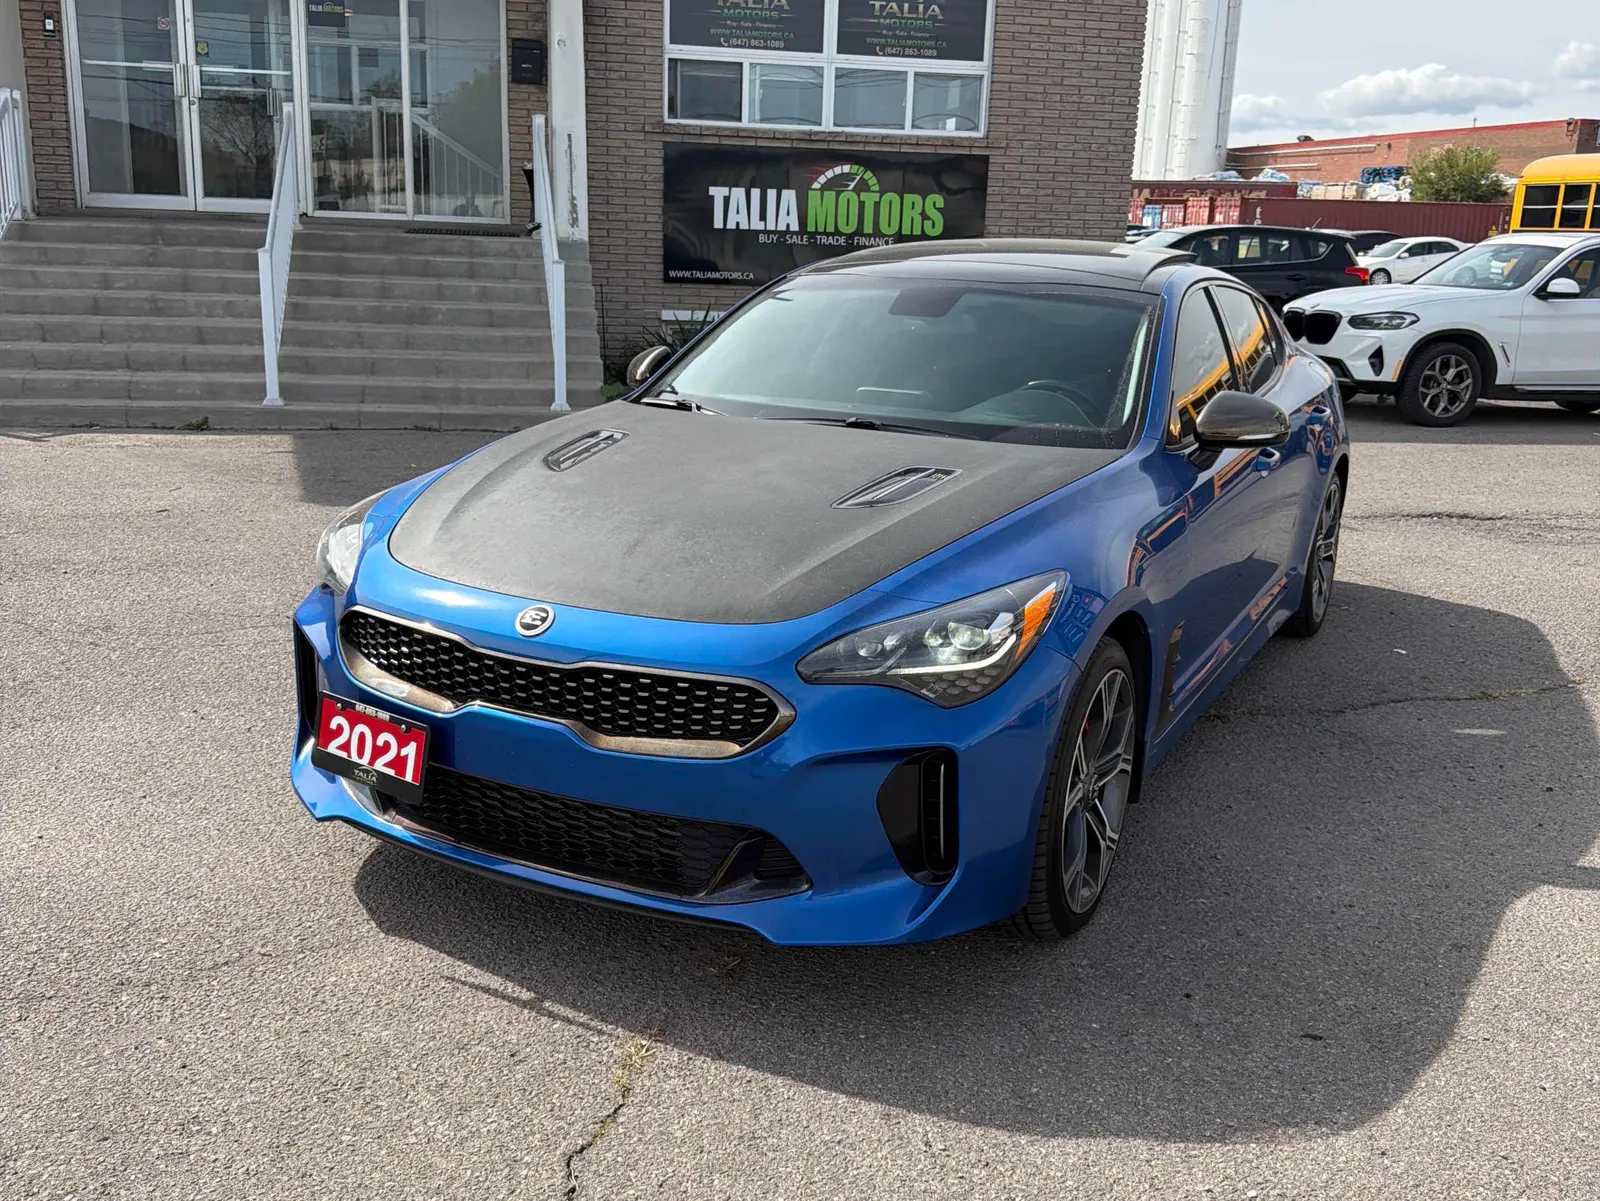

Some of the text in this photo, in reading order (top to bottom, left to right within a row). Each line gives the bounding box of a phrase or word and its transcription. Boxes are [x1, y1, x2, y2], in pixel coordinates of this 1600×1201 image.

[723, 8, 780, 20] MOTORS
[879, 18, 933, 29] MOTORS
[709, 28, 795, 40] WWW.TALIAMOTORS.CA
[729, 38, 785, 48] (647) 863-1089
[884, 46, 938, 57] (647) 863-1089
[708, 186, 945, 237] TALIA MOTORS
[758, 233, 779, 244] BUY
[785, 234, 809, 245] SALE
[815, 235, 847, 246] TRADE
[854, 236, 894, 246] FINANCE
[668, 270, 755, 280] WWW.TALIAMOTORS.CA
[327, 715, 417, 783] 2021
[353, 768, 378, 784] TALIA
